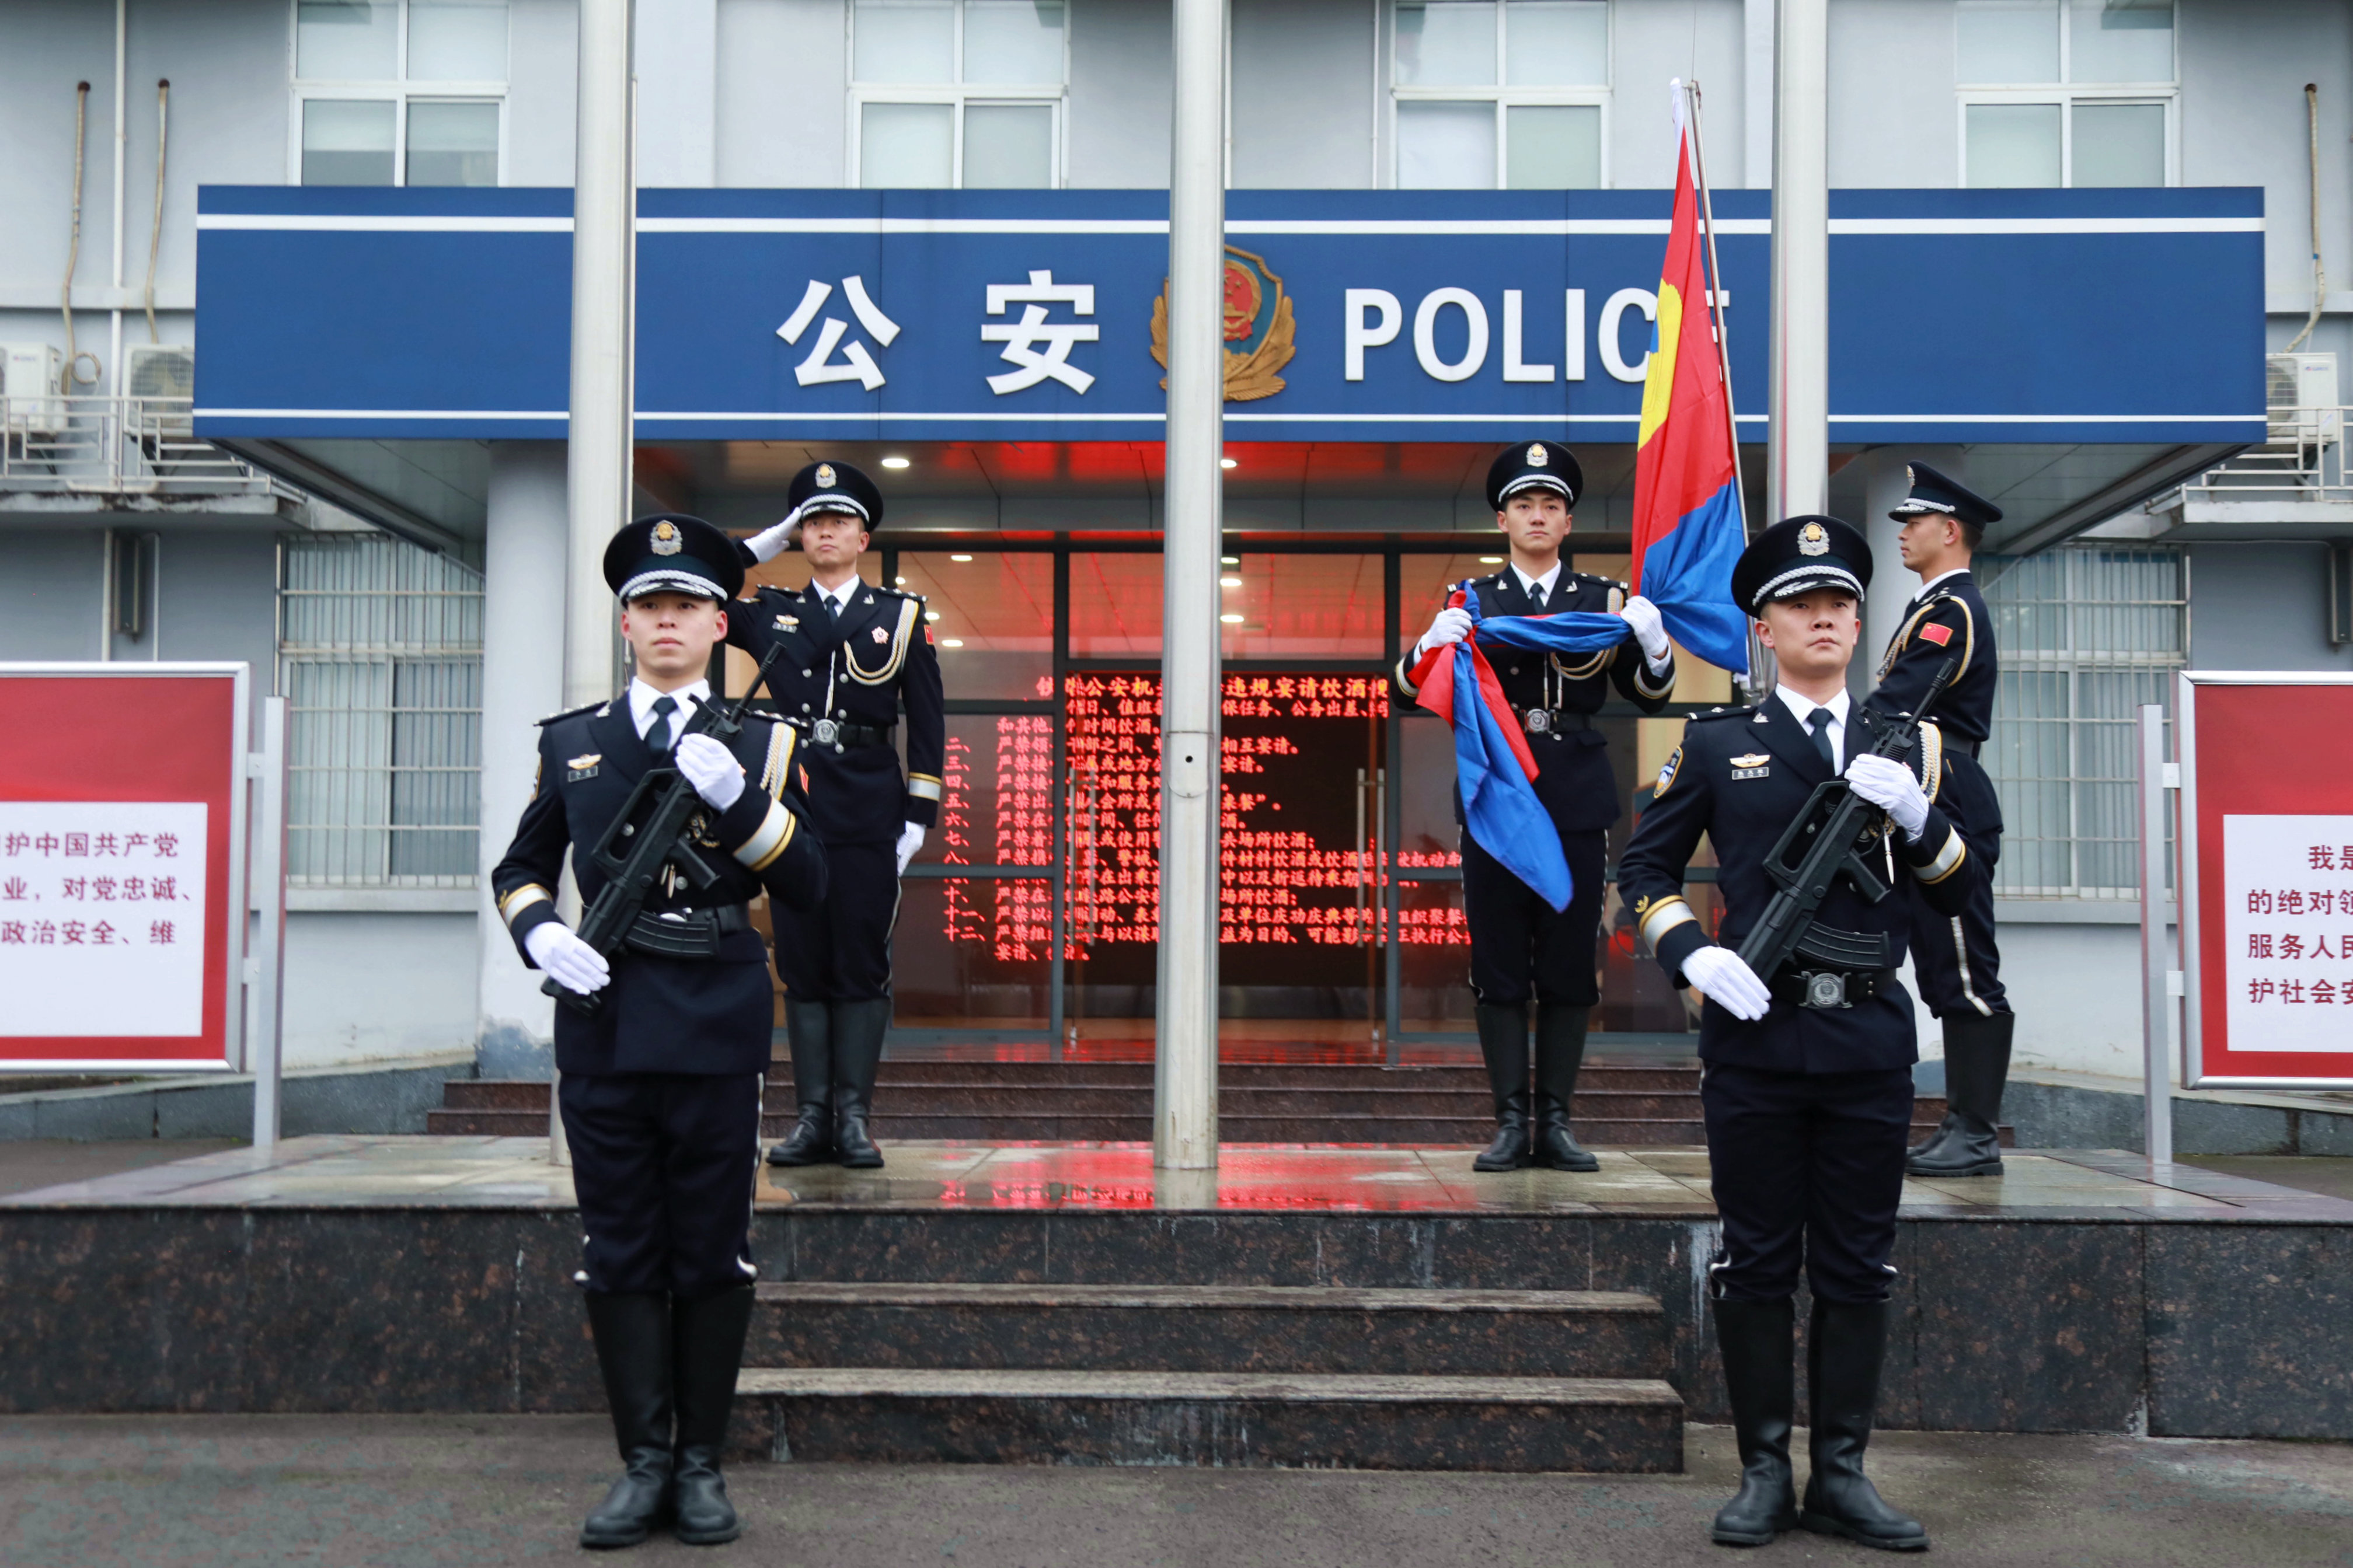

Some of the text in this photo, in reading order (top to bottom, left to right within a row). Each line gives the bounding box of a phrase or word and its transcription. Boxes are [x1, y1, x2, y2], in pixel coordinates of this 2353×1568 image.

[776, 269, 1099, 395] 公安
[1344, 287, 1730, 383] POLIC
[5, 832, 179, 858] 护中国共产党
[1, 920, 176, 945] 政治安全、维
